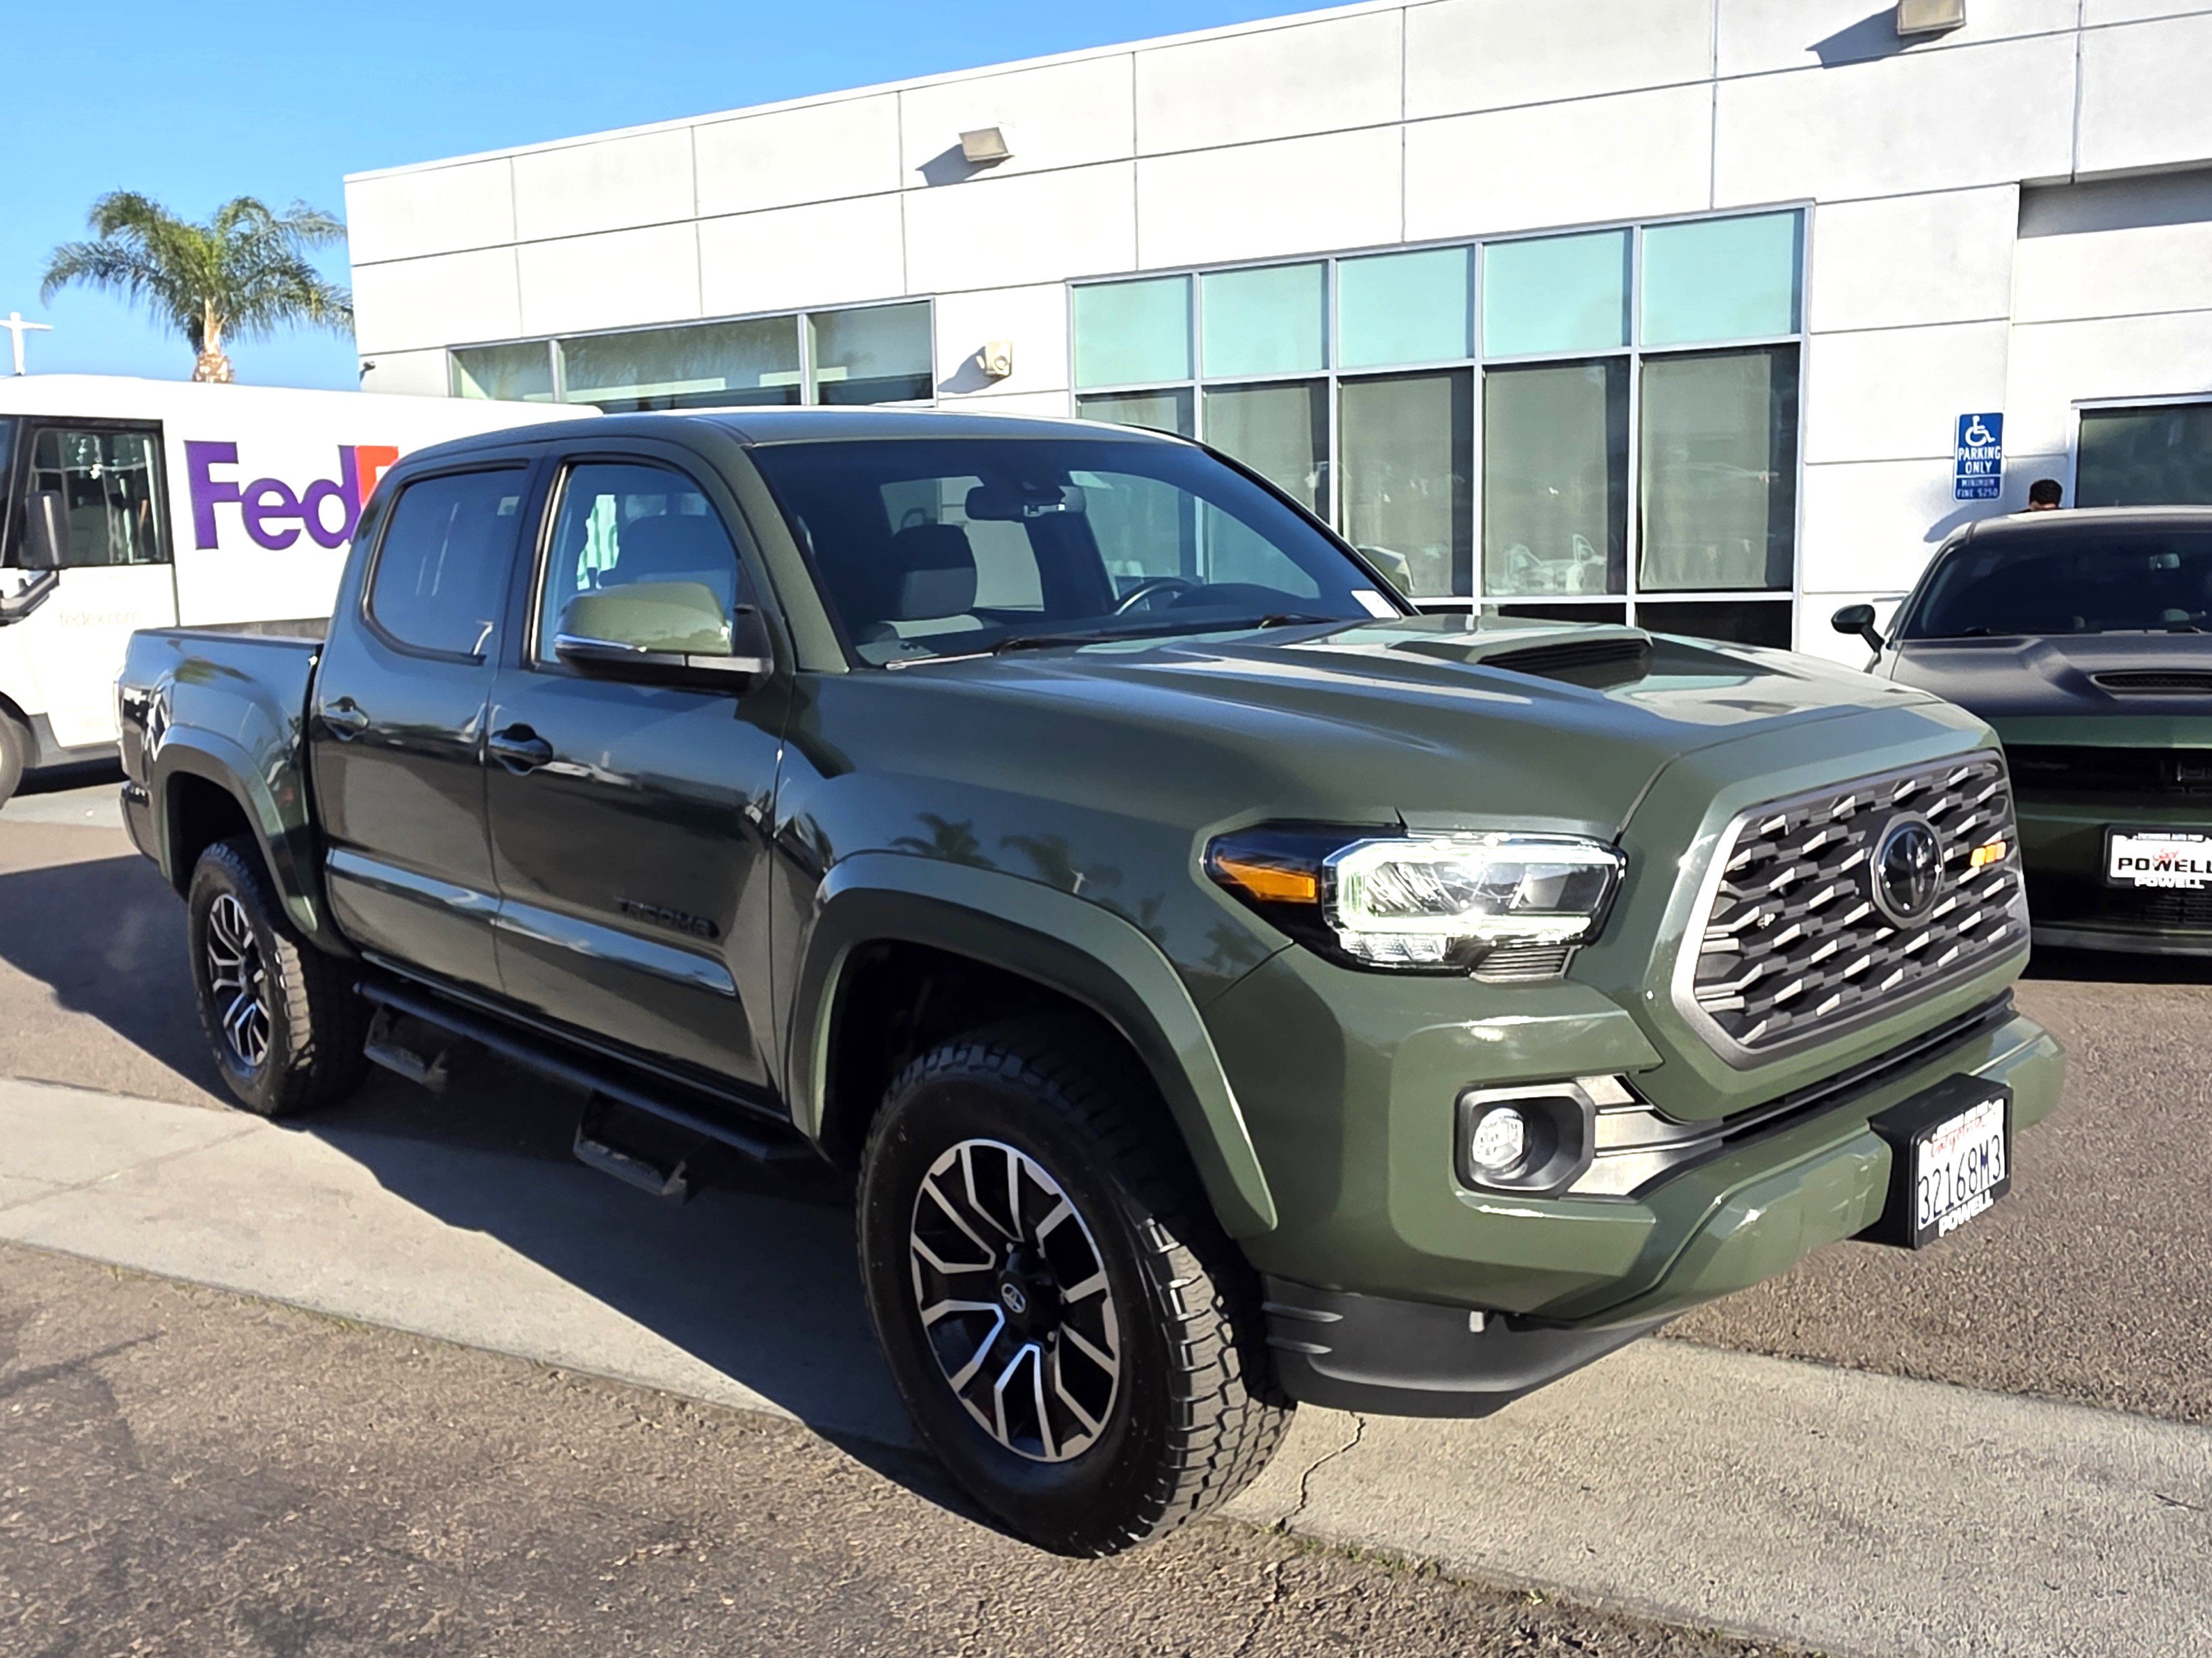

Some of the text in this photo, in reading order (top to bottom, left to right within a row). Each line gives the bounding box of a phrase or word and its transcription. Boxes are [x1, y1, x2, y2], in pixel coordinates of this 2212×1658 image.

[1959, 446, 2001, 460] PARKING
[1965, 461, 1992, 474] ONLY
[1957, 489, 1974, 498] FINE
[2135, 877, 2205, 889] POWELL
[1918, 1134, 2001, 1224] 32168M3
[1939, 1190, 1993, 1237] POWELL
